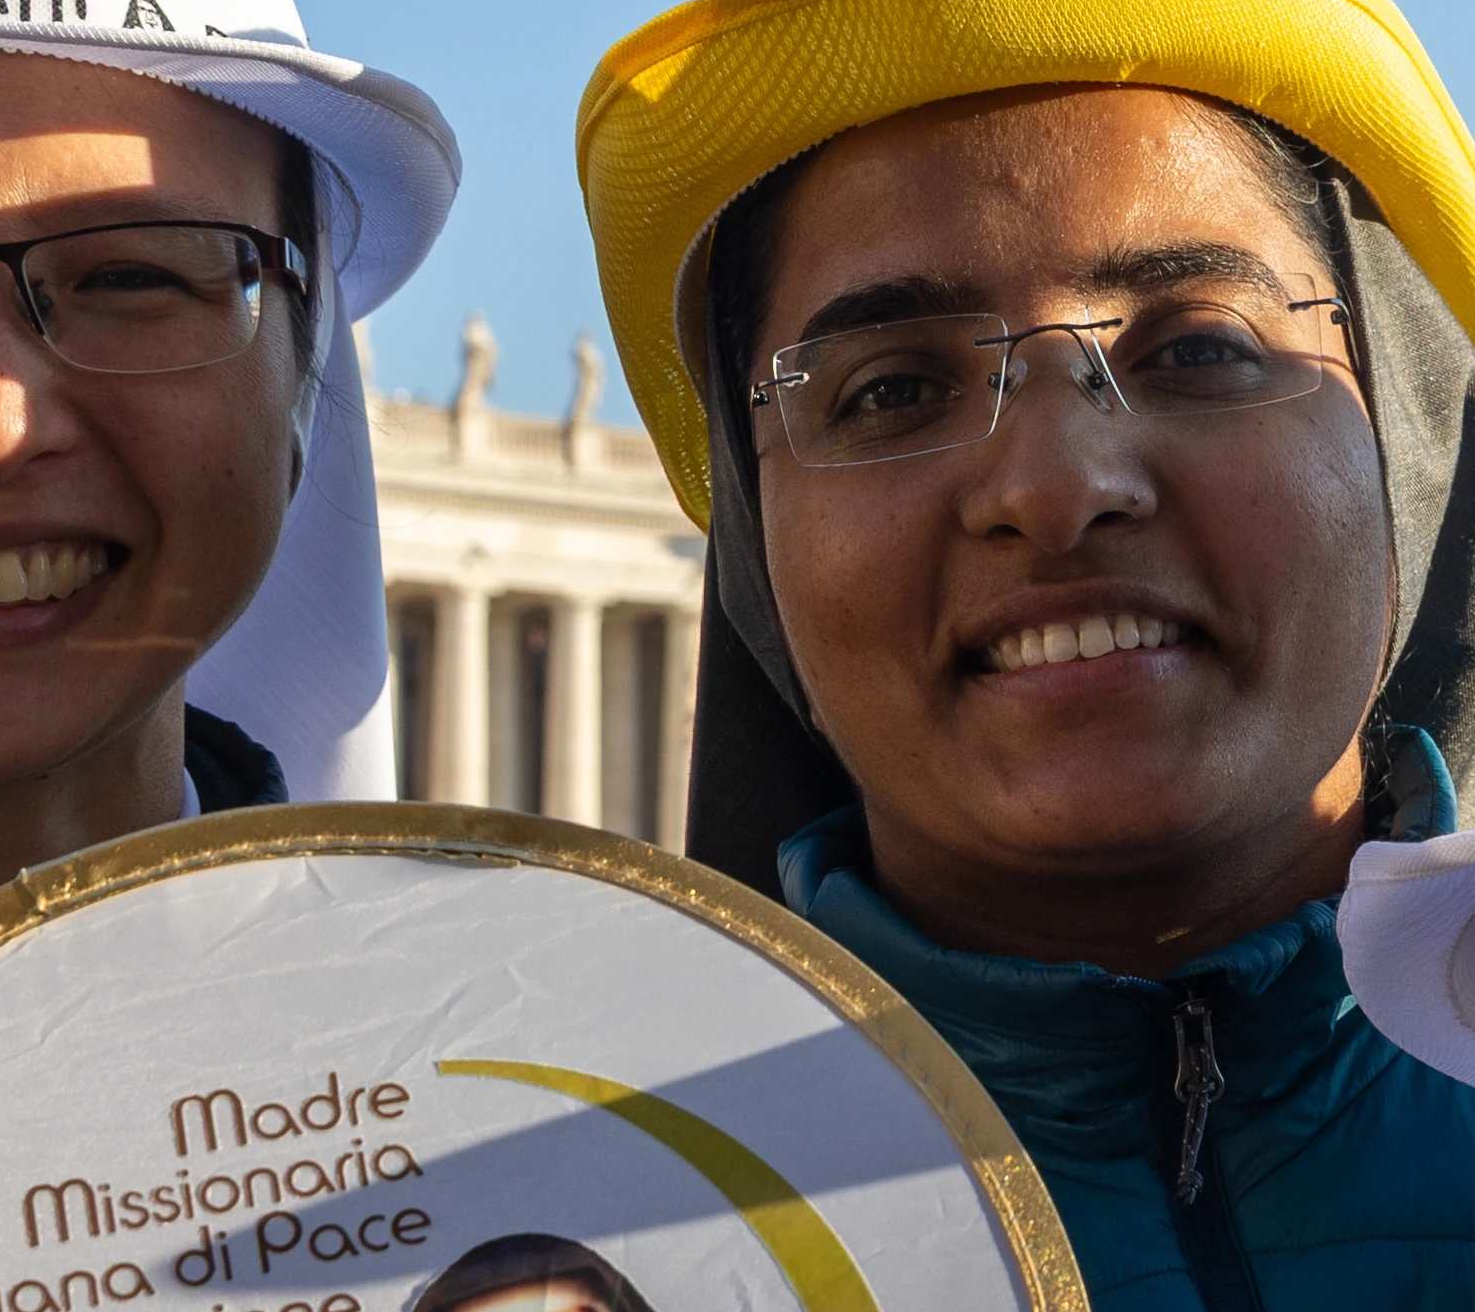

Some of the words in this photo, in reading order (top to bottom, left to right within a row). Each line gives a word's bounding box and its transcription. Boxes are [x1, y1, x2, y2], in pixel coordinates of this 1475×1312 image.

[172, 1072, 410, 1157] Madre
[24, 1138, 424, 1247] Missionaria
[174, 1226, 232, 1287] di
[256, 1207, 431, 1274] Pace
